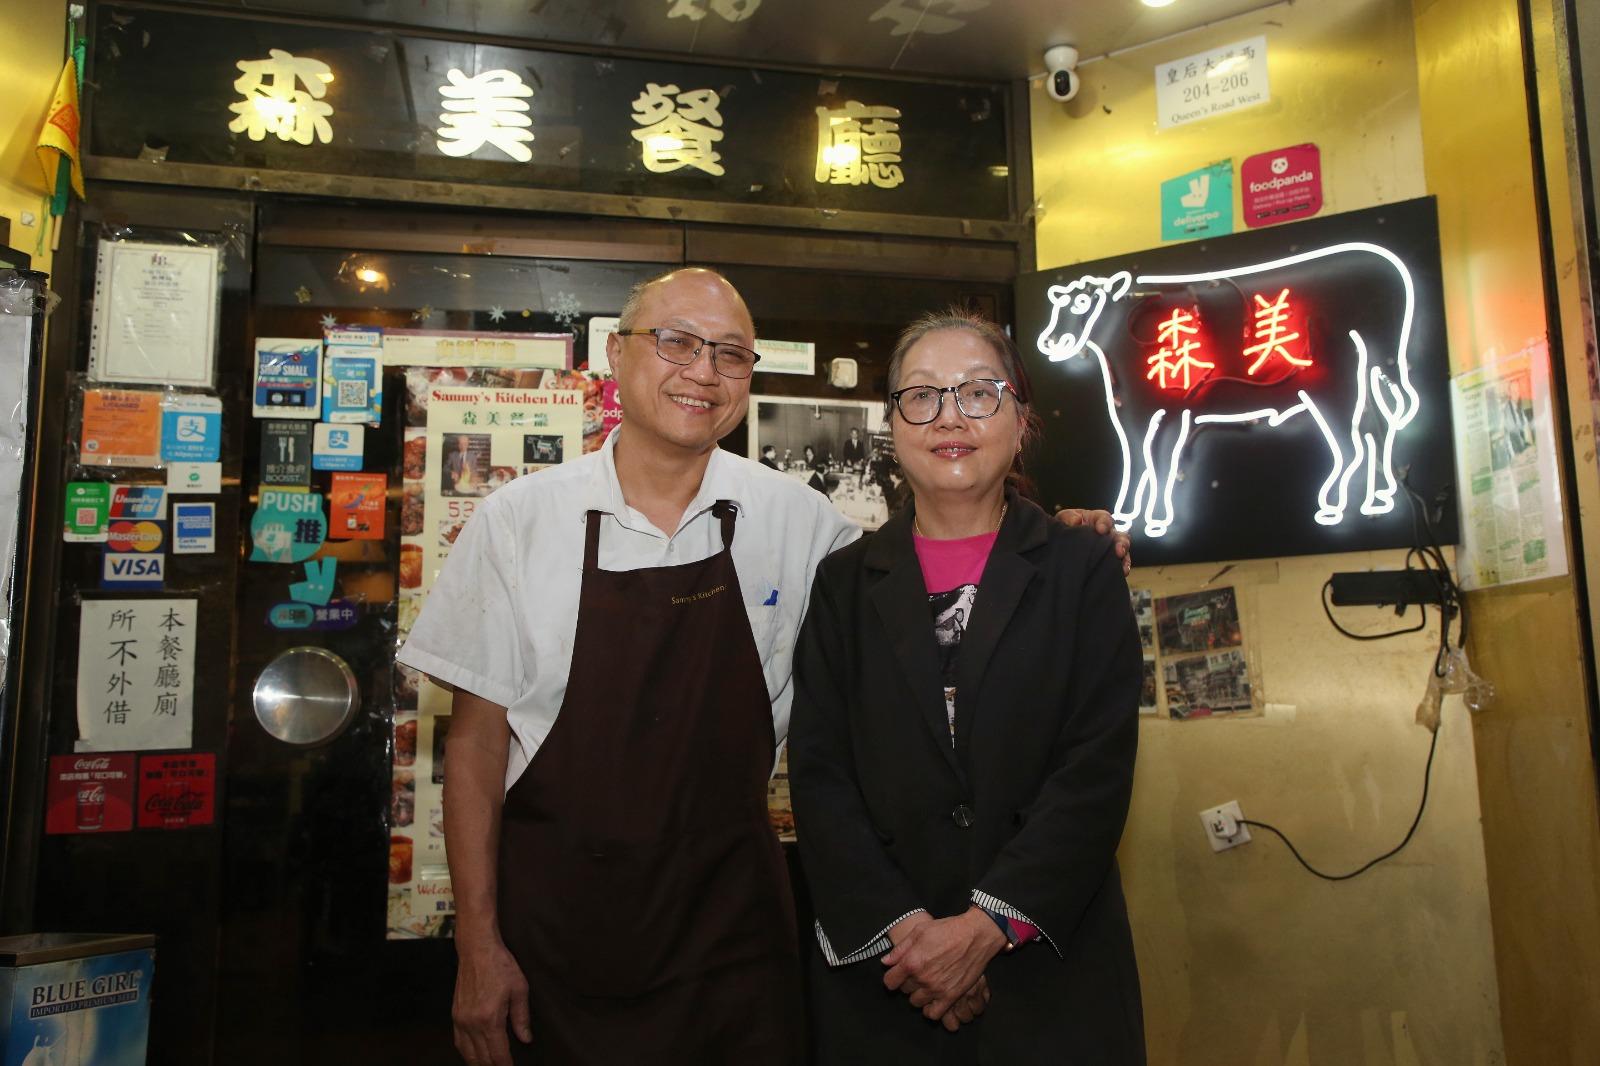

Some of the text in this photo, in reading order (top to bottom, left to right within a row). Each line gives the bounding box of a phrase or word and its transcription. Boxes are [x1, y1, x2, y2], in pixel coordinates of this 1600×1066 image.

[1183, 72, 1249, 103] 204-206
[228, 48, 904, 188] 森美餐廳
[1171, 92, 1261, 124] Queen's Road West
[1249, 171, 1314, 194] foodpanda
[1173, 211, 1221, 227] deliveroo
[1146, 288, 1314, 391] 森美
[282, 365, 309, 377] SMALL
[432, 390, 578, 405] Sammy's Kitchen Ltd.
[115, 493, 161, 505] UnionPay
[263, 492, 318, 513] PUSH
[109, 531, 161, 543] MasterCard
[295, 518, 321, 544] 推
[111, 559, 161, 576] VISA
[315, 608, 354, 621] 營業中
[104, 608, 138, 725] 所不外借
[154, 607, 185, 717] 本餐廳廁
[74, 758, 111, 770] Coca-Cola
[32, 973, 137, 1006] BLUE GIRL
[32, 990, 137, 1018] IMPORTED PREMIUM BEER
